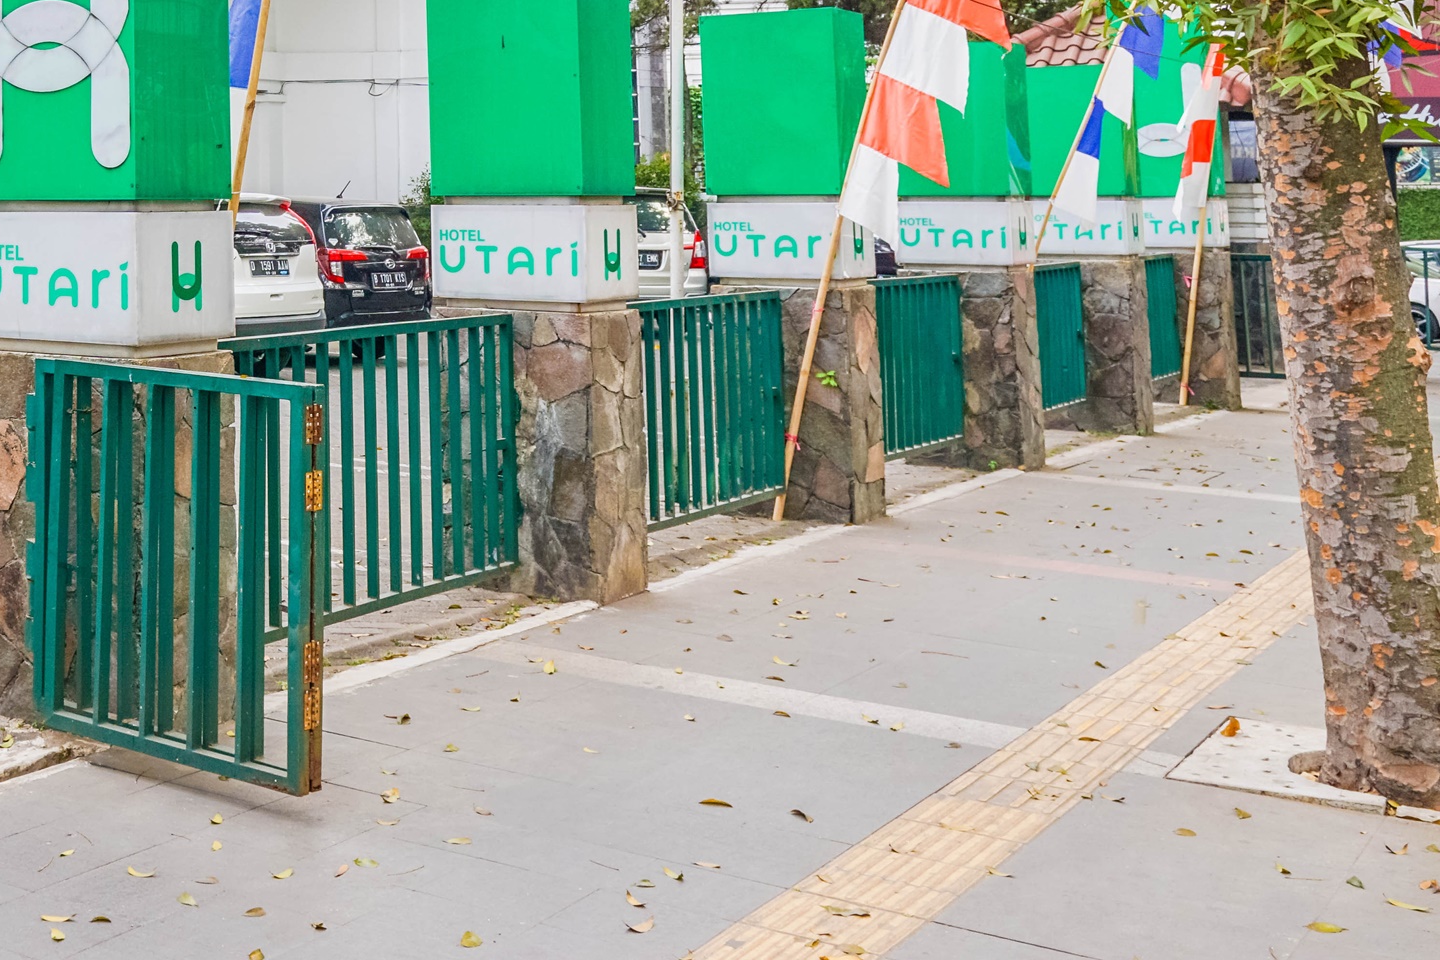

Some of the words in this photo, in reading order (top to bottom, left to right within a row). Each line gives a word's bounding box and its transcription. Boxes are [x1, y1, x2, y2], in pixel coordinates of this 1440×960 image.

[714, 221, 754, 232] HOTEL
[900, 217, 935, 227] HOTEL
[439, 229, 485, 242] HOTEL
